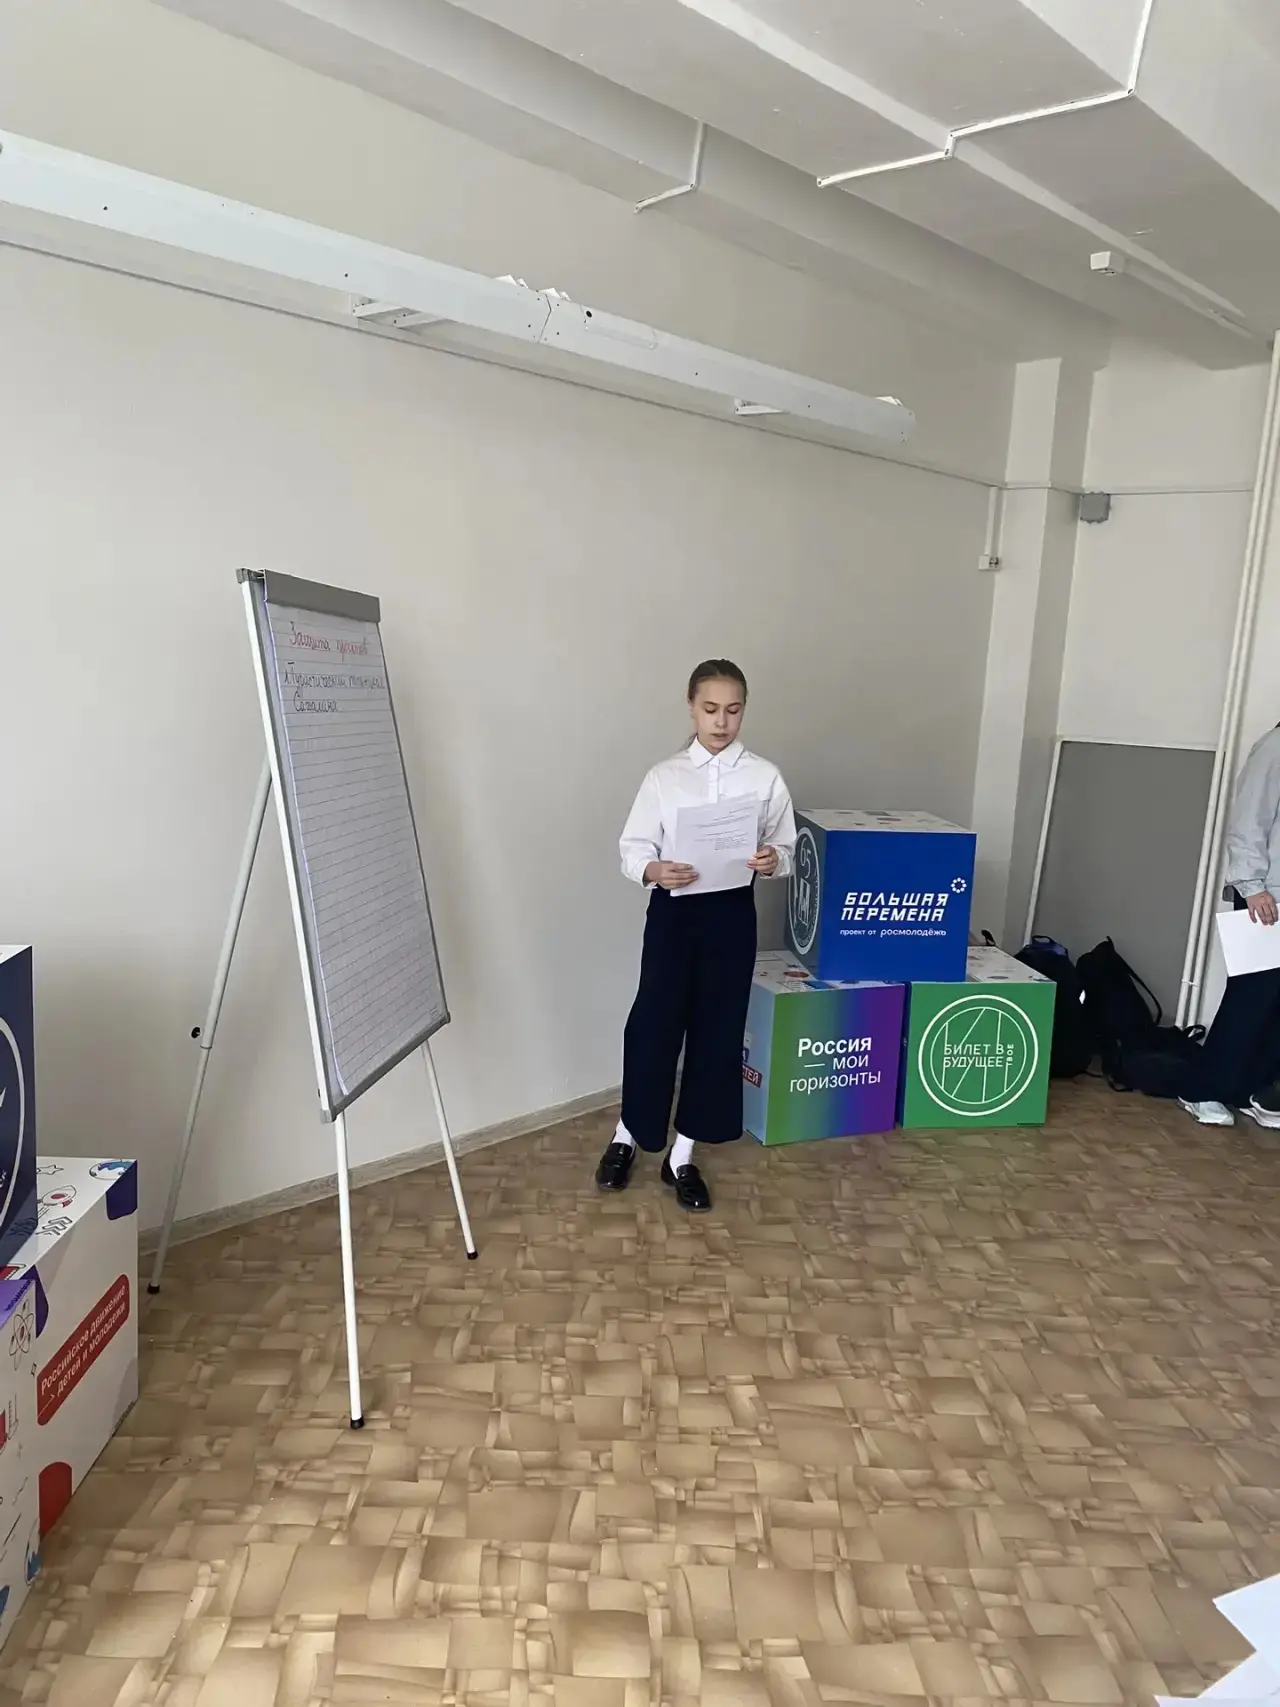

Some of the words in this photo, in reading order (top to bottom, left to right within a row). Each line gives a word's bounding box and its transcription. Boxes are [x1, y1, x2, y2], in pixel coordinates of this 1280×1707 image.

[844, 892, 949, 907] БОЛЬШАЯ
[840, 907, 945, 922] ПЕРЕМЕНА
[840, 929, 866, 937] проект
[798, 1036, 872, 1058] Россия
[943, 1043, 992, 1056] БИЛЕТ
[995, 1043, 1005, 1056] В
[1006, 1043, 1014, 1066] ТВОЕ
[832, 1054, 869, 1071] мои
[943, 1056, 1004, 1068] БУДУЩЕЕ
[790, 1071, 881, 1095] горизонты
[40, 1329, 90, 1396] Российское
[89, 1285, 126, 1337] движение
